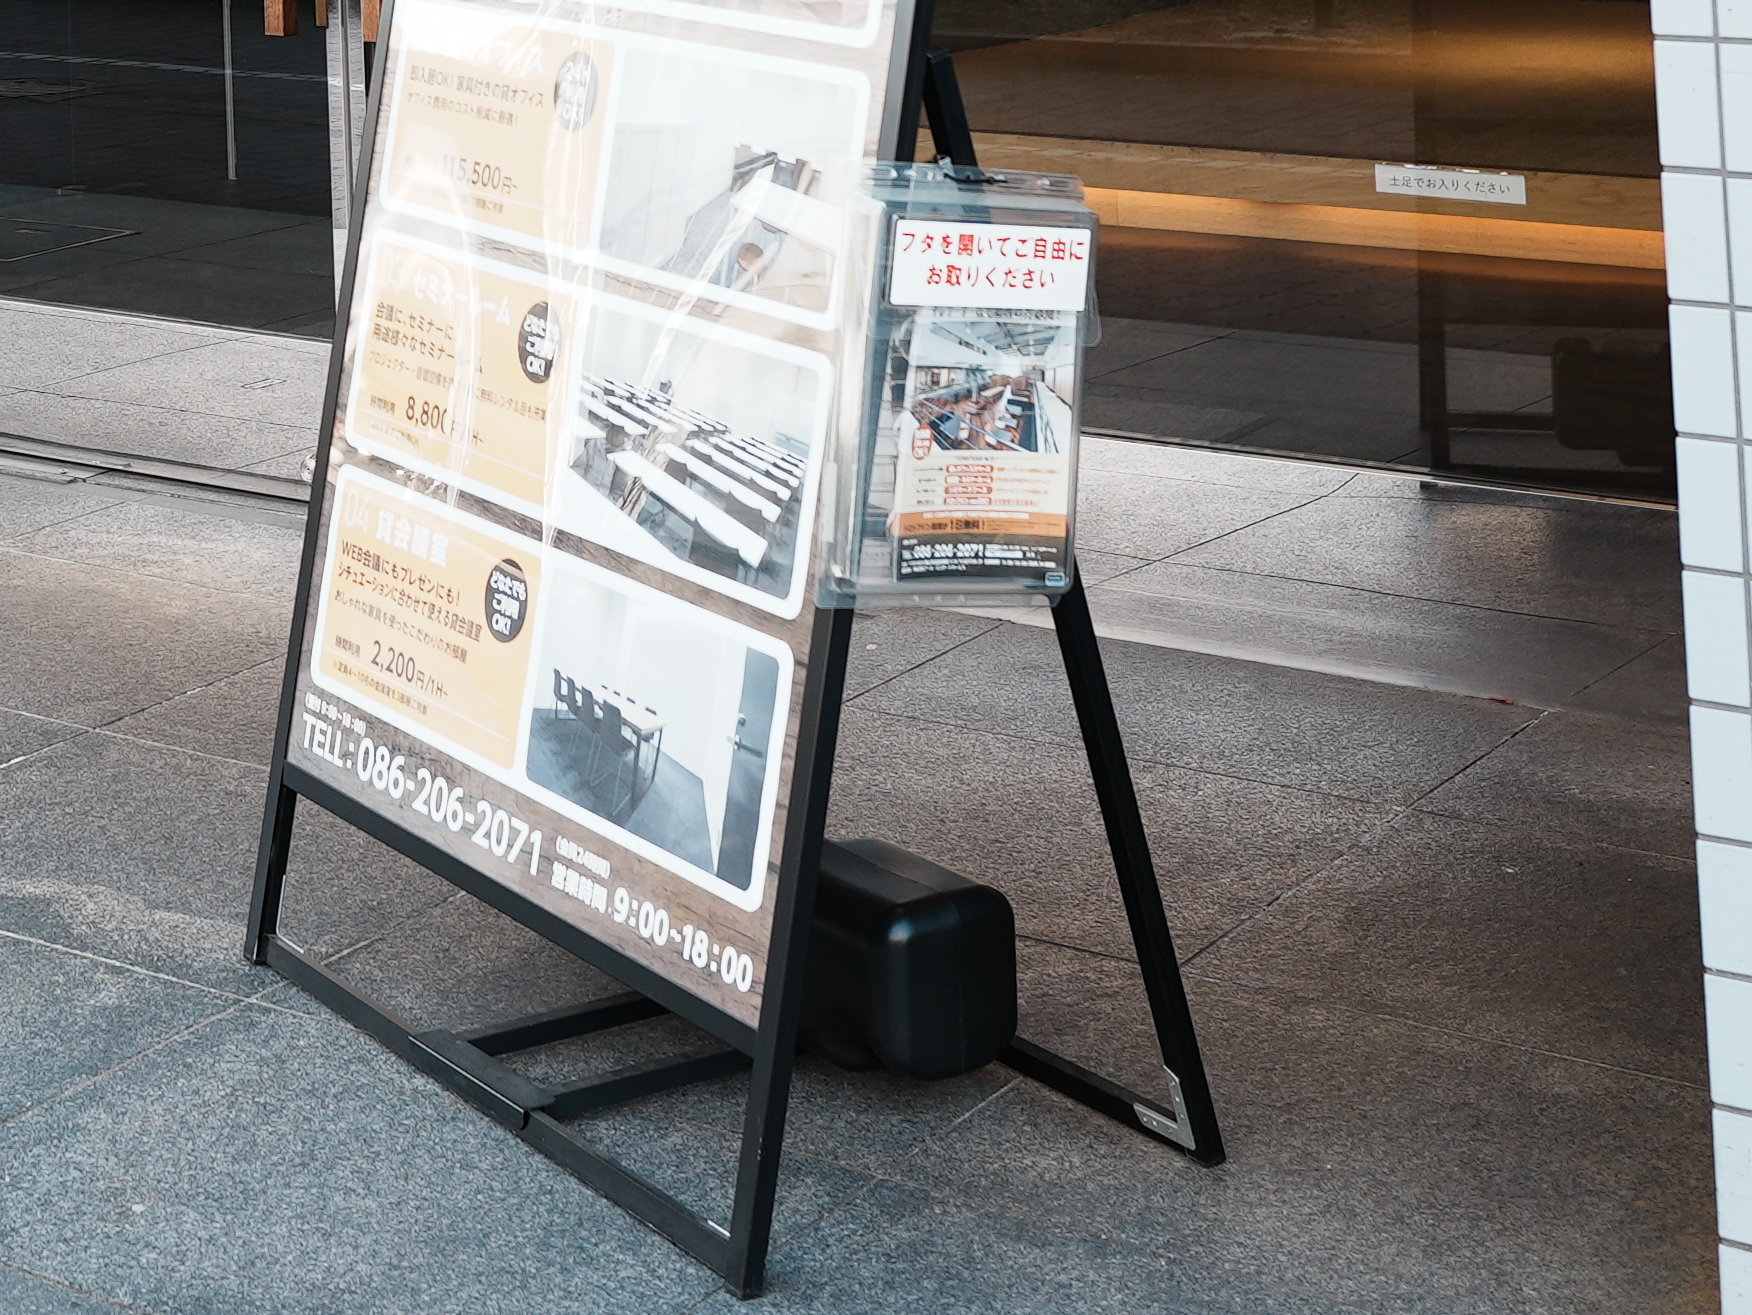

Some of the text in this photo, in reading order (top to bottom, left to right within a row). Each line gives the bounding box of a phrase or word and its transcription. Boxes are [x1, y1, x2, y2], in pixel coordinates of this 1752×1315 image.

[1389, 174, 1511, 194] 土足でお入りください
[901, 232, 1086, 261] フタを開いてご自由に
[926, 264, 1055, 289] お取りください
[412, 271, 512, 326] セミナールーム
[375, 509, 451, 568] 貸会議室
[338, 562, 484, 643] シチュエーションに合わせて使える貸会議室
